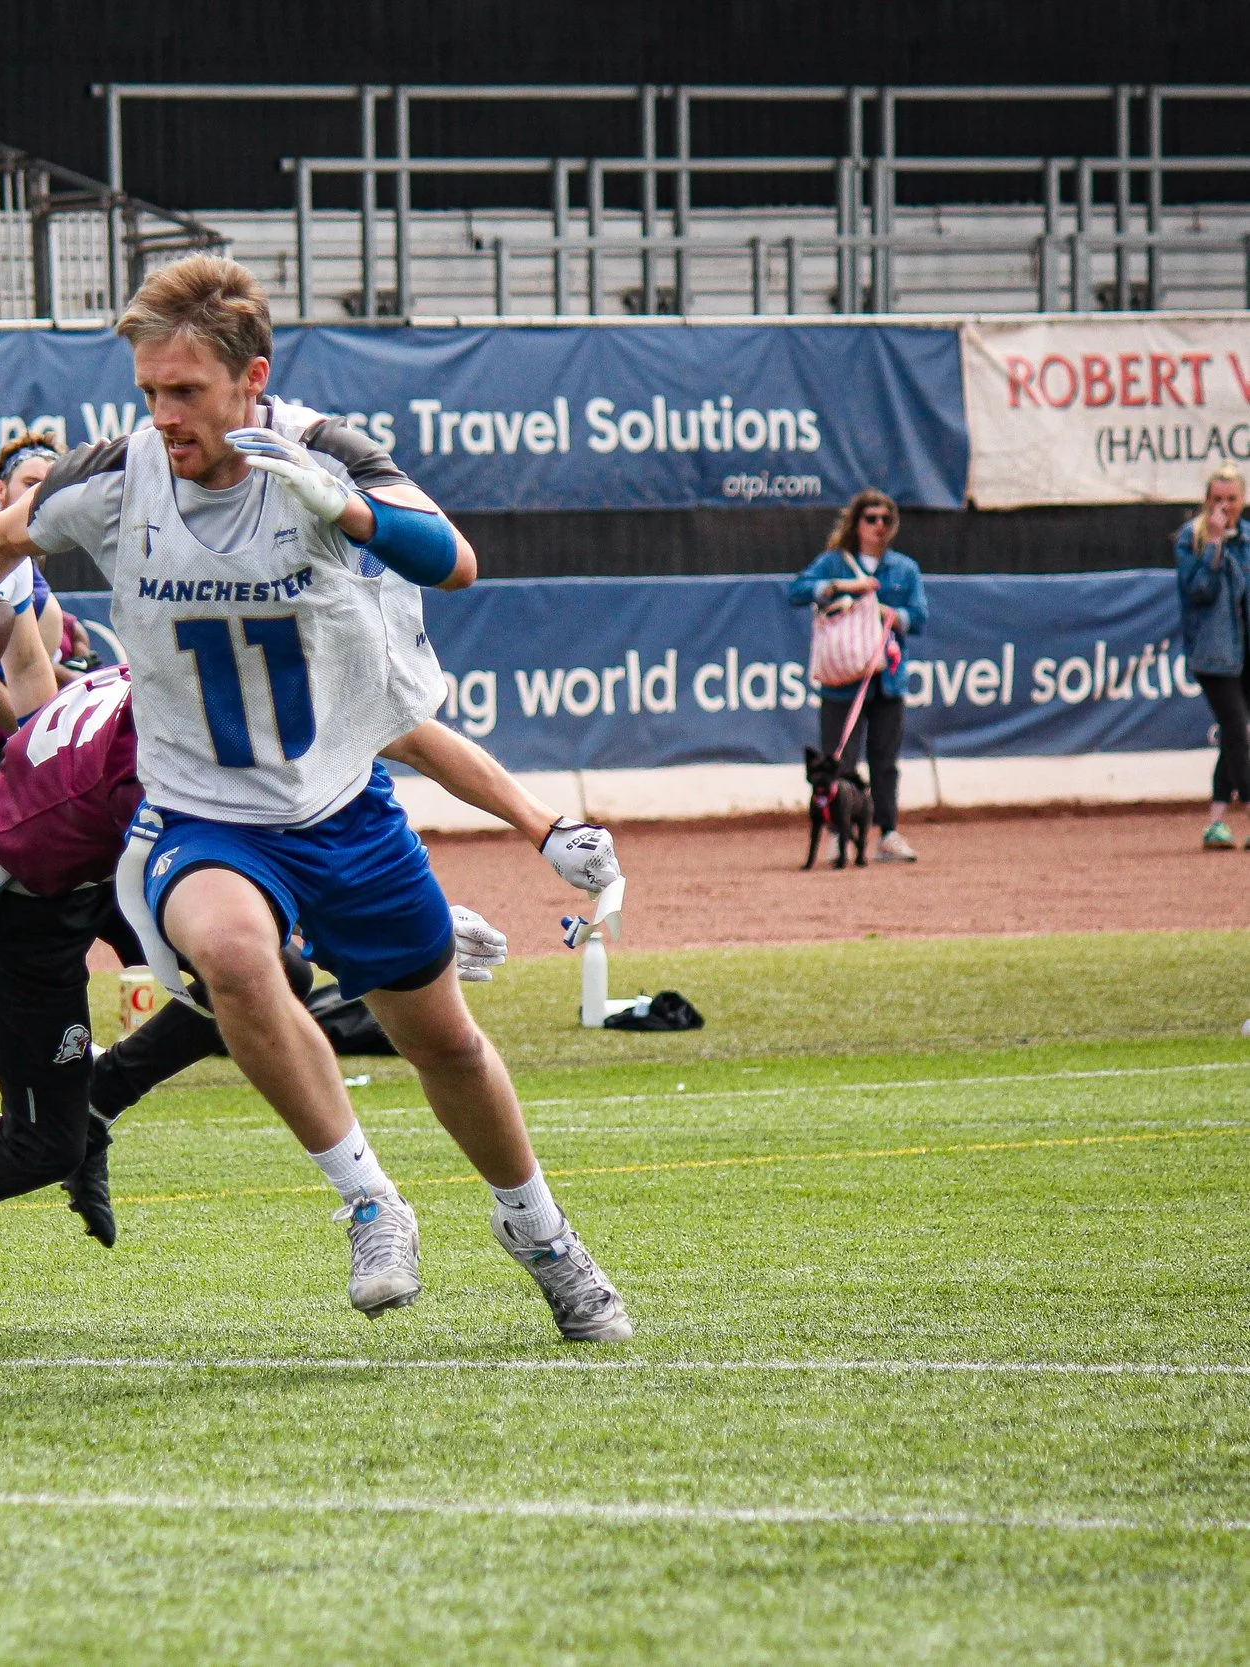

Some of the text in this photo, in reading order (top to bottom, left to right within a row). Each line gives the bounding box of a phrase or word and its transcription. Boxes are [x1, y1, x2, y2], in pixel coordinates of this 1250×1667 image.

[1006, 352, 1212, 408] ROBERT
[409, 396, 571, 455] Travel
[585, 394, 821, 452] Solutions
[722, 470, 821, 501] atpi.com
[138, 566, 314, 602] MANCHESTER
[172, 612, 317, 768] 11
[514, 649, 677, 718] world
[905, 642, 1015, 707] avel
